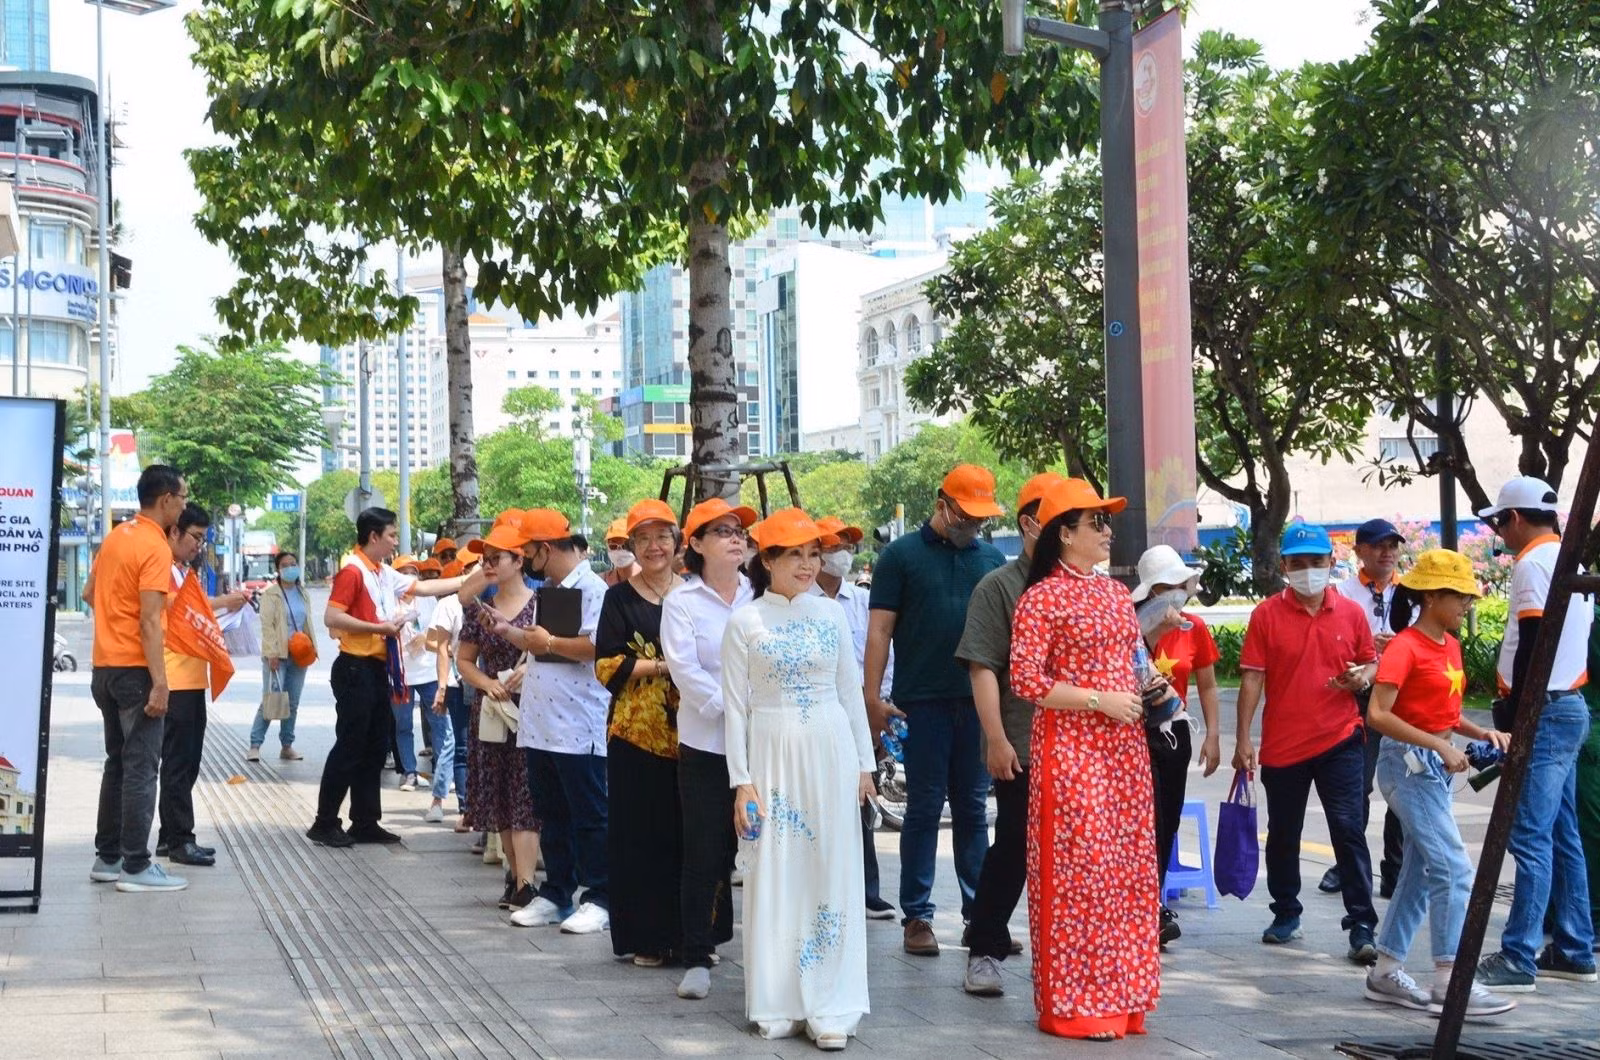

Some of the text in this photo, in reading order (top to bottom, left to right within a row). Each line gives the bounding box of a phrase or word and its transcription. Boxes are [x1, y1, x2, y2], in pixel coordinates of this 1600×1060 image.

[10, 516, 31, 525] GIA
[28, 528, 44, 539] VÀ
[14, 540, 40, 553] PHỐ
[16, 580, 36, 588] SITE
[20, 591, 40, 599] AND
